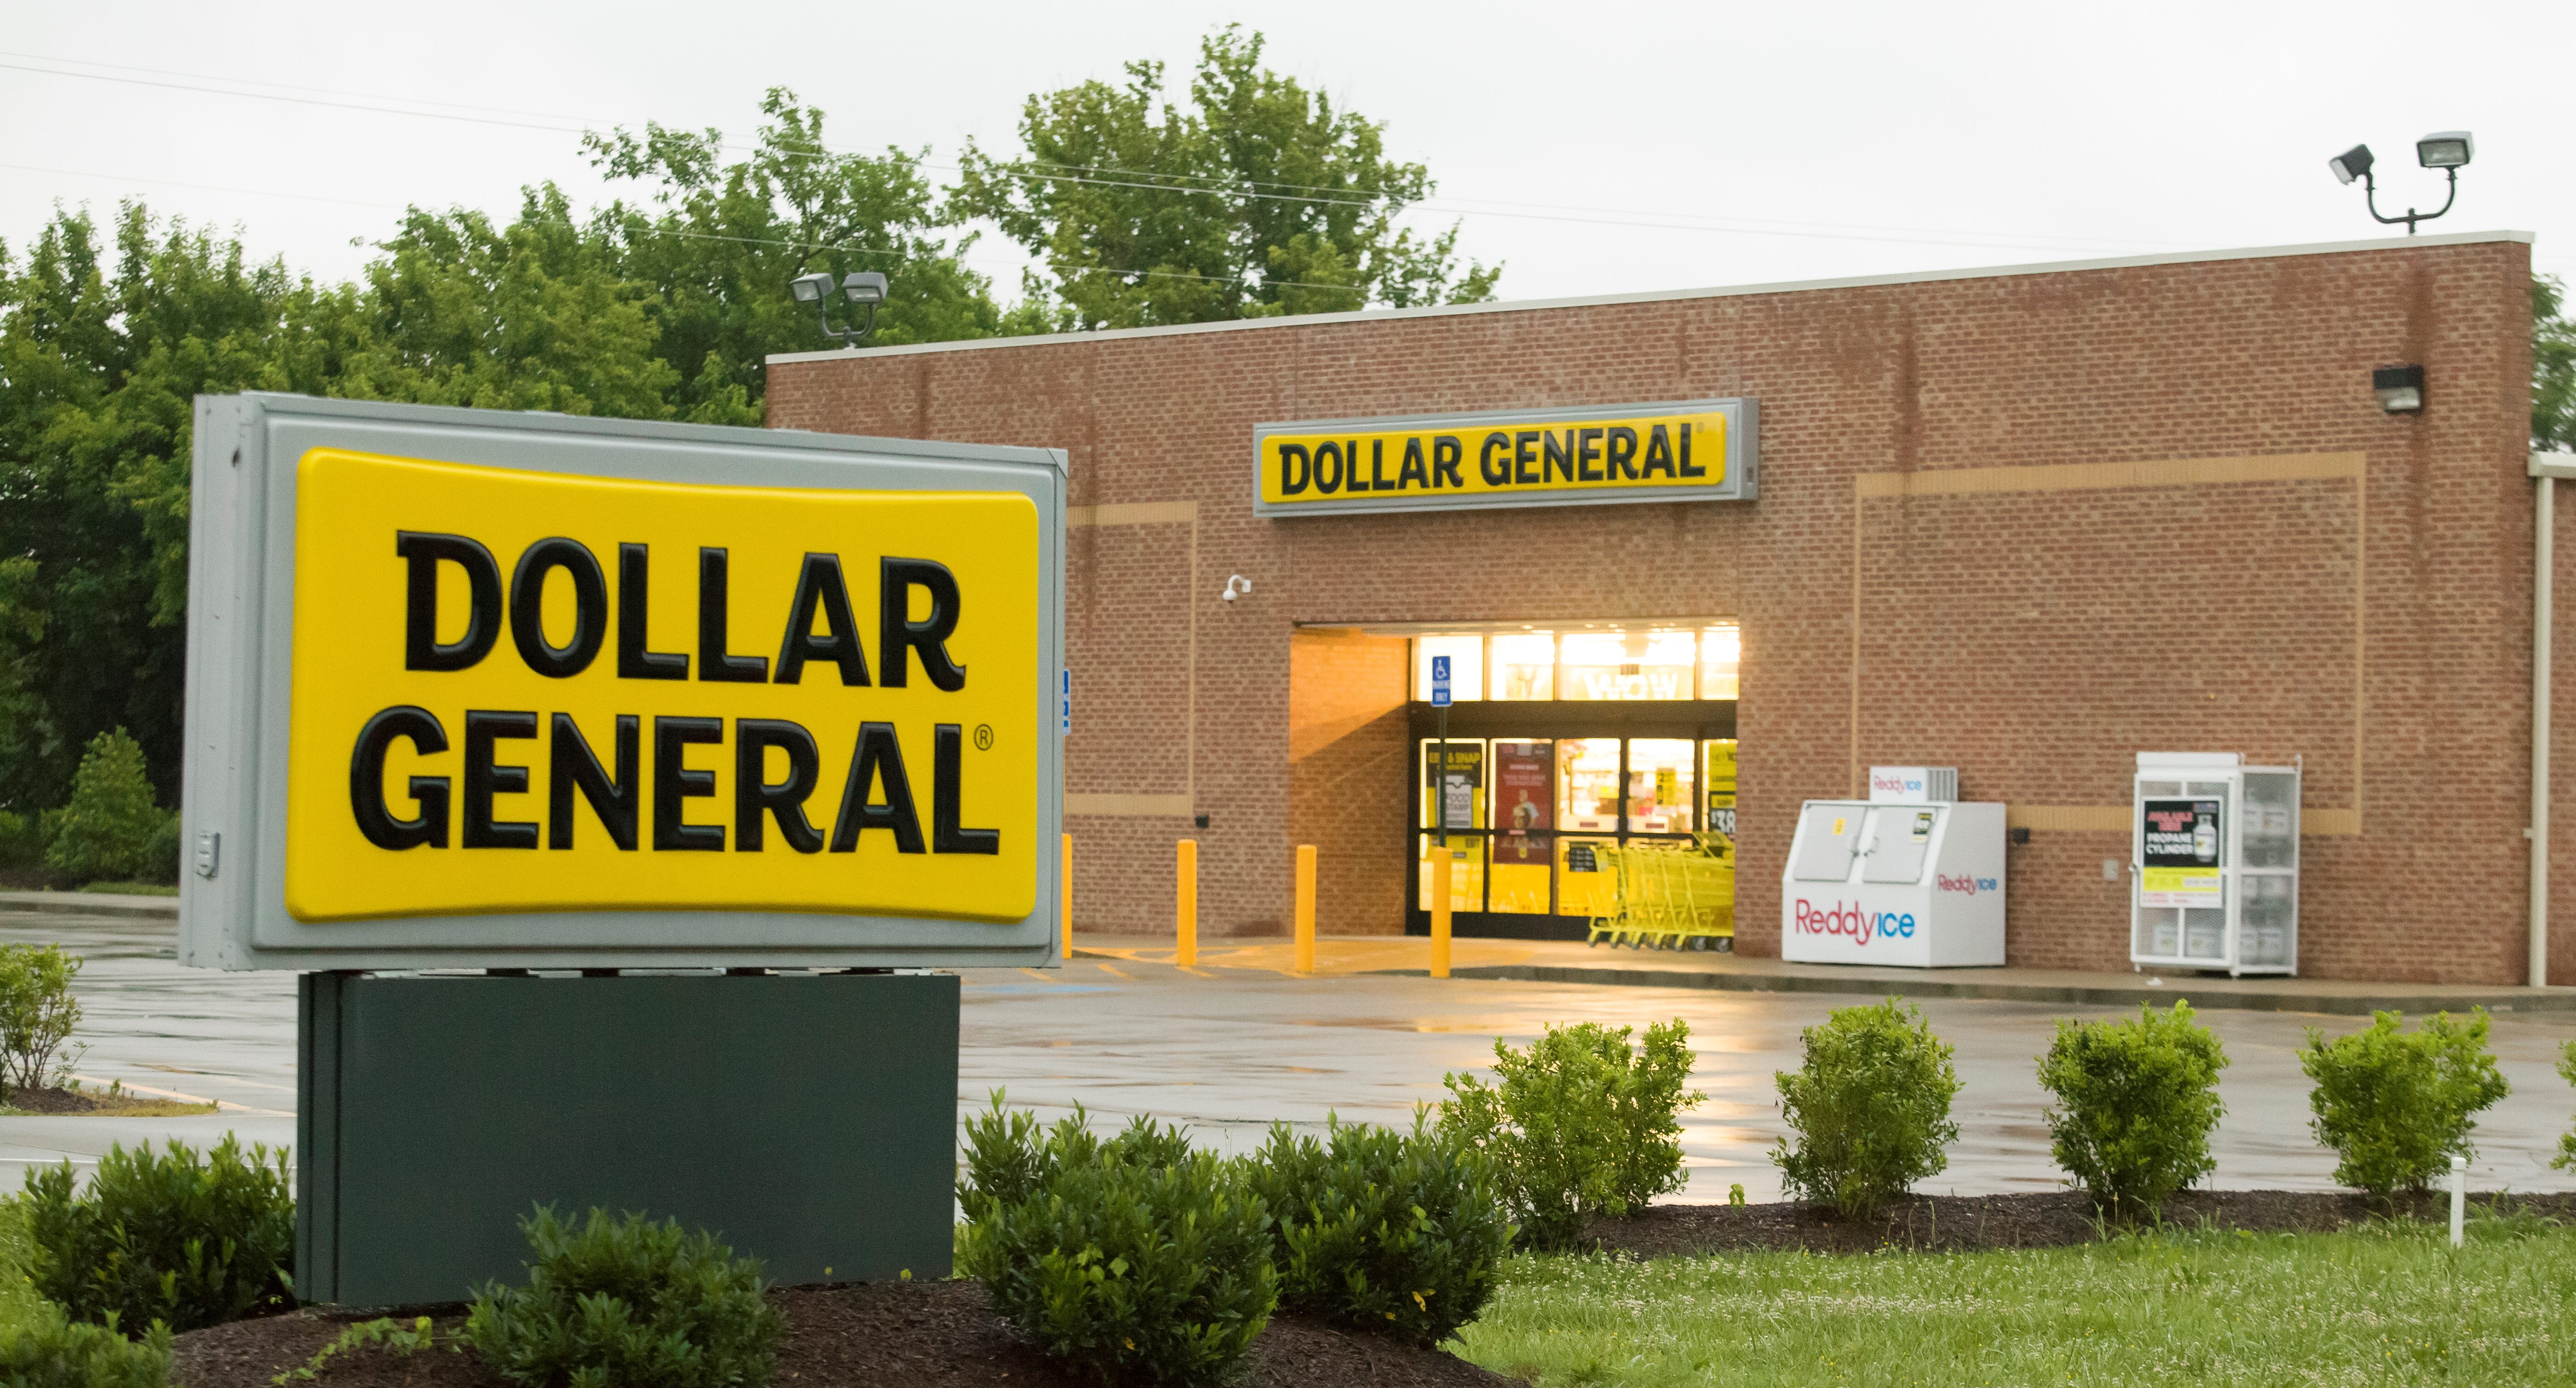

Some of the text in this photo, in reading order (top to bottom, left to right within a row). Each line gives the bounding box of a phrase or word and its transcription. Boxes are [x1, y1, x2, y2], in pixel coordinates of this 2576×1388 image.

[1279, 423, 1705, 495] DOLLAR GENERAL
[396, 529, 967, 692] DOLLAR
[350, 705, 1000, 855] GENERAL
